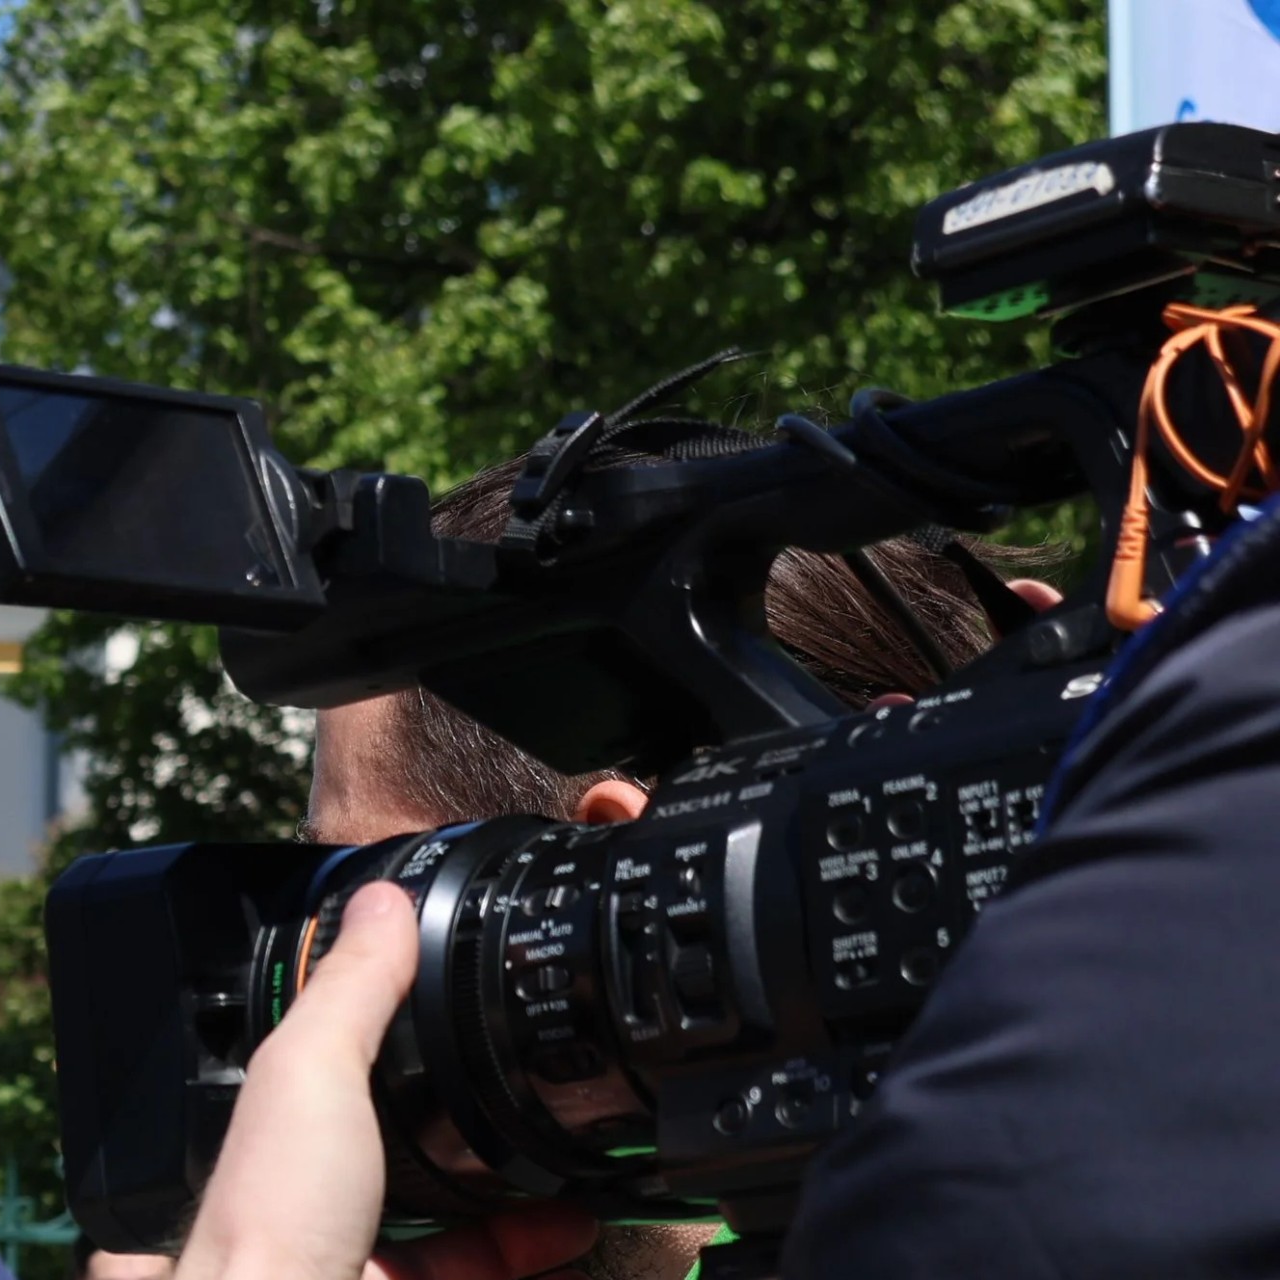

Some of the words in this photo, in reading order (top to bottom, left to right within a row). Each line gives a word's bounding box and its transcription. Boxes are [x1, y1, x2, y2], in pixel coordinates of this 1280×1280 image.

[925, 781, 938, 802] 2
[930, 847, 944, 868] 4
[865, 861, 879, 882] 3
[936, 926, 951, 948] 5
[525, 942, 565, 961] MACRO
